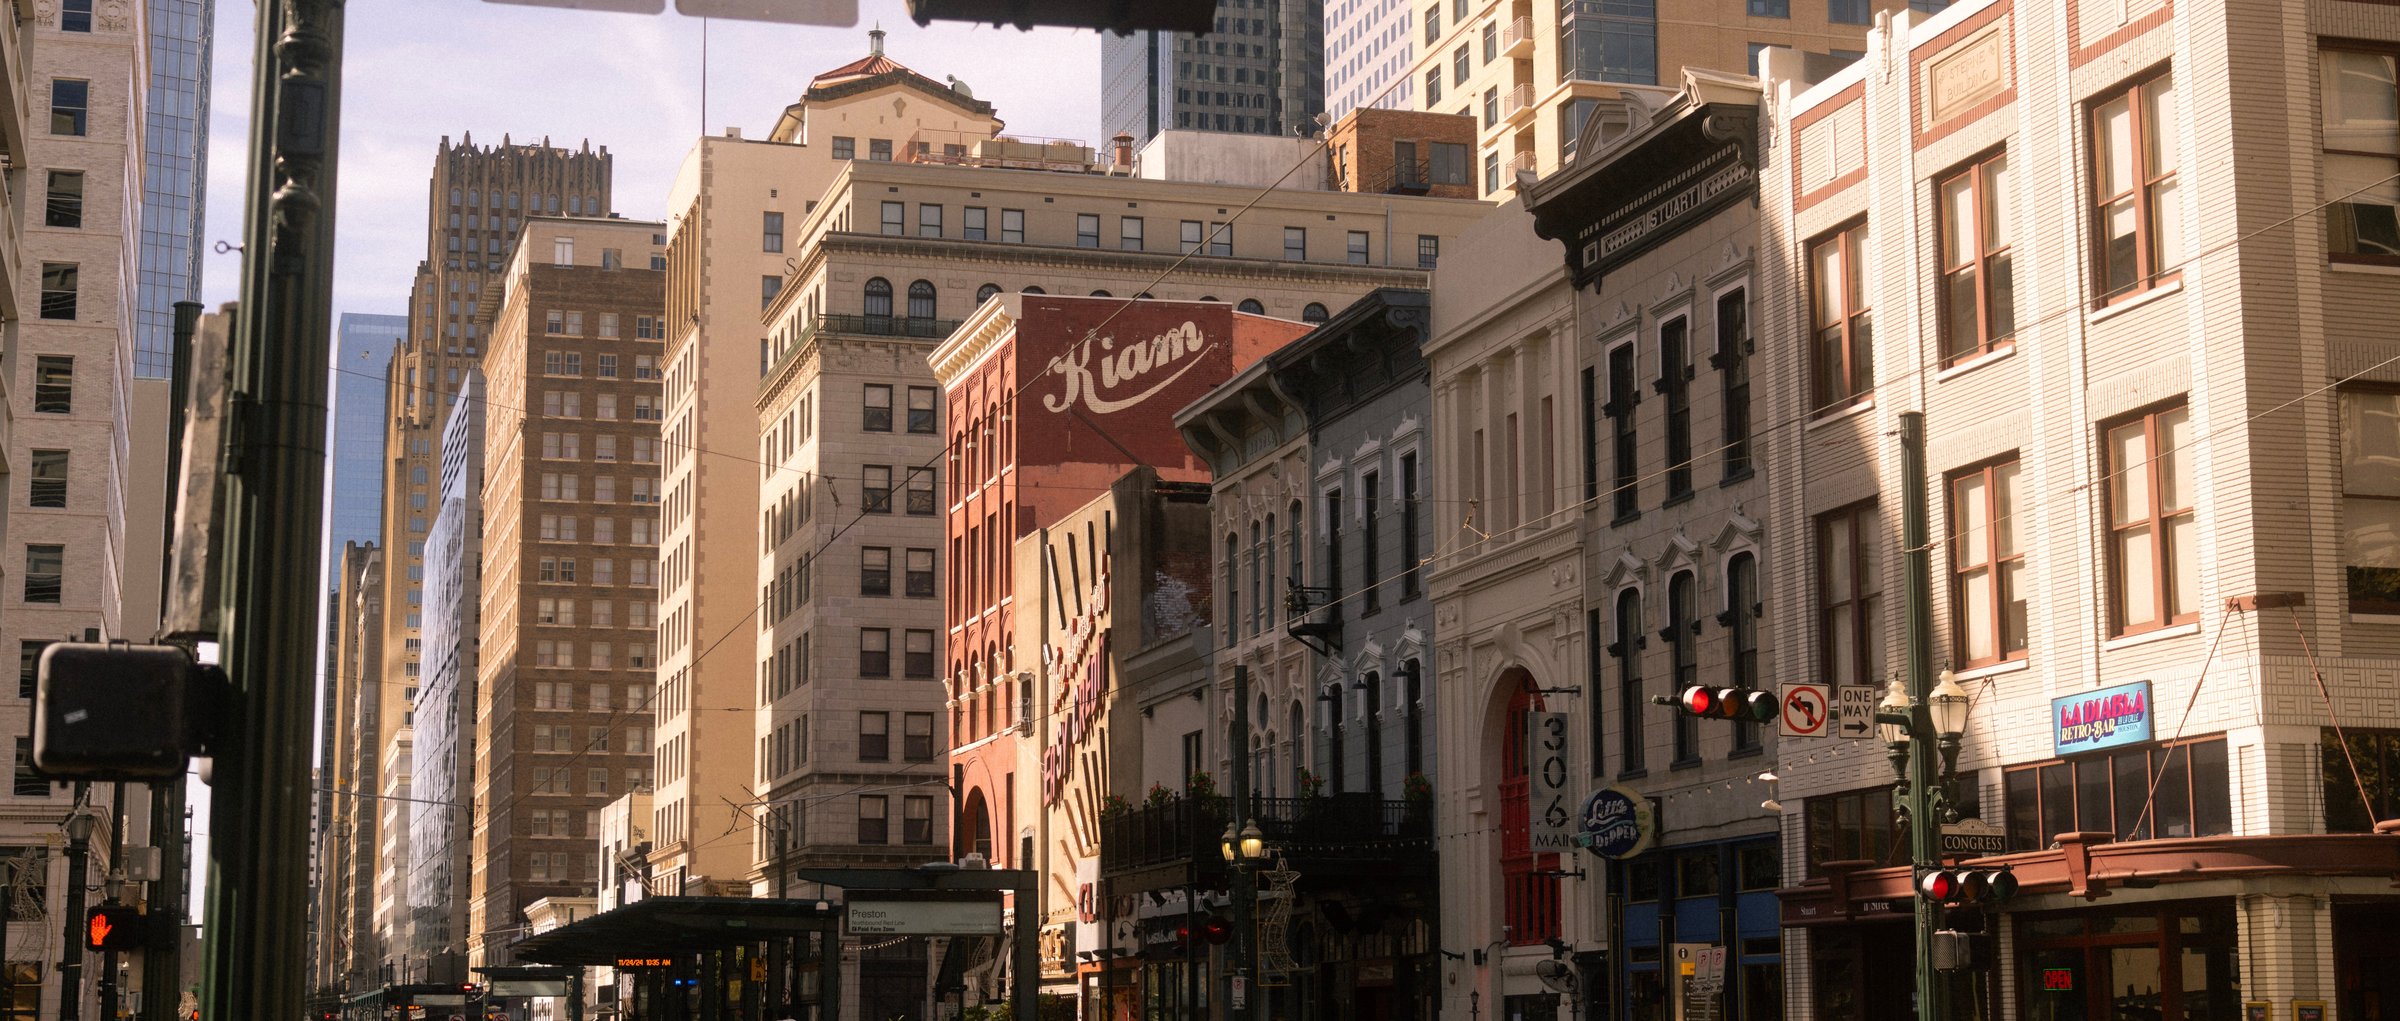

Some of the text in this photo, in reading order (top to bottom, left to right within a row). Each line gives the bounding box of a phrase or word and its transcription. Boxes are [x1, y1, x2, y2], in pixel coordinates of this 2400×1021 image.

[1650, 187, 1697, 229] STUART
[1043, 320, 1212, 414] Kiam
[1844, 690, 1871, 702] ONE
[1043, 632, 1108, 807] EASY CREDIT
[1843, 704, 1871, 717] WAY
[2061, 690, 2145, 728] LA DIABLA
[2061, 718, 2116, 742] RETRO-BAR
[1543, 717, 1570, 828] 306
[1587, 799, 1628, 828] Little
[1944, 836, 2003, 850] CONGRESS
[851, 909, 887, 919] Preston
[1800, 905, 1817, 916] Stuart
[2045, 970, 2071, 989] OPEN
